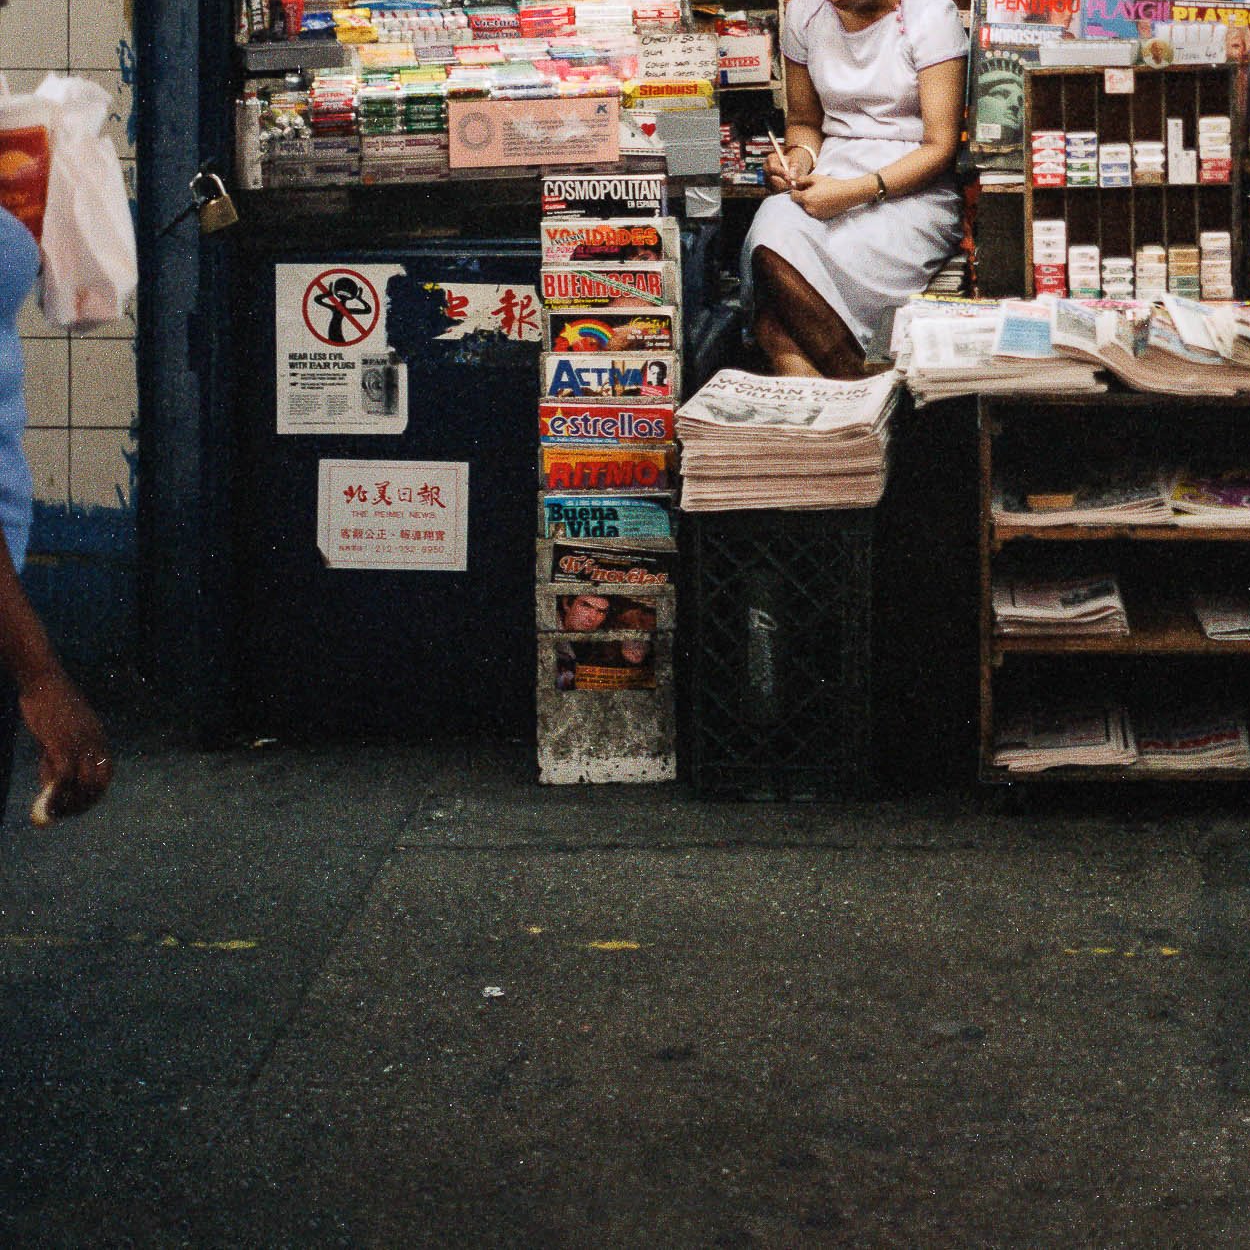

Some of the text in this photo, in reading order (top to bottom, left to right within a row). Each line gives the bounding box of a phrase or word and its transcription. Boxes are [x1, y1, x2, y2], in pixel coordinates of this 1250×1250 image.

[639, 83, 698, 96] Starburst
[544, 180, 661, 200] COSMOPOLITAN
[288, 352, 308, 360] HEAR
[310, 352, 327, 360] LESS
[549, 412, 666, 438] estrellas
[549, 460, 659, 488] RITMO
[352, 510, 368, 518] THE
[548, 504, 620, 522] Buena
[565, 521, 620, 538] Vida
